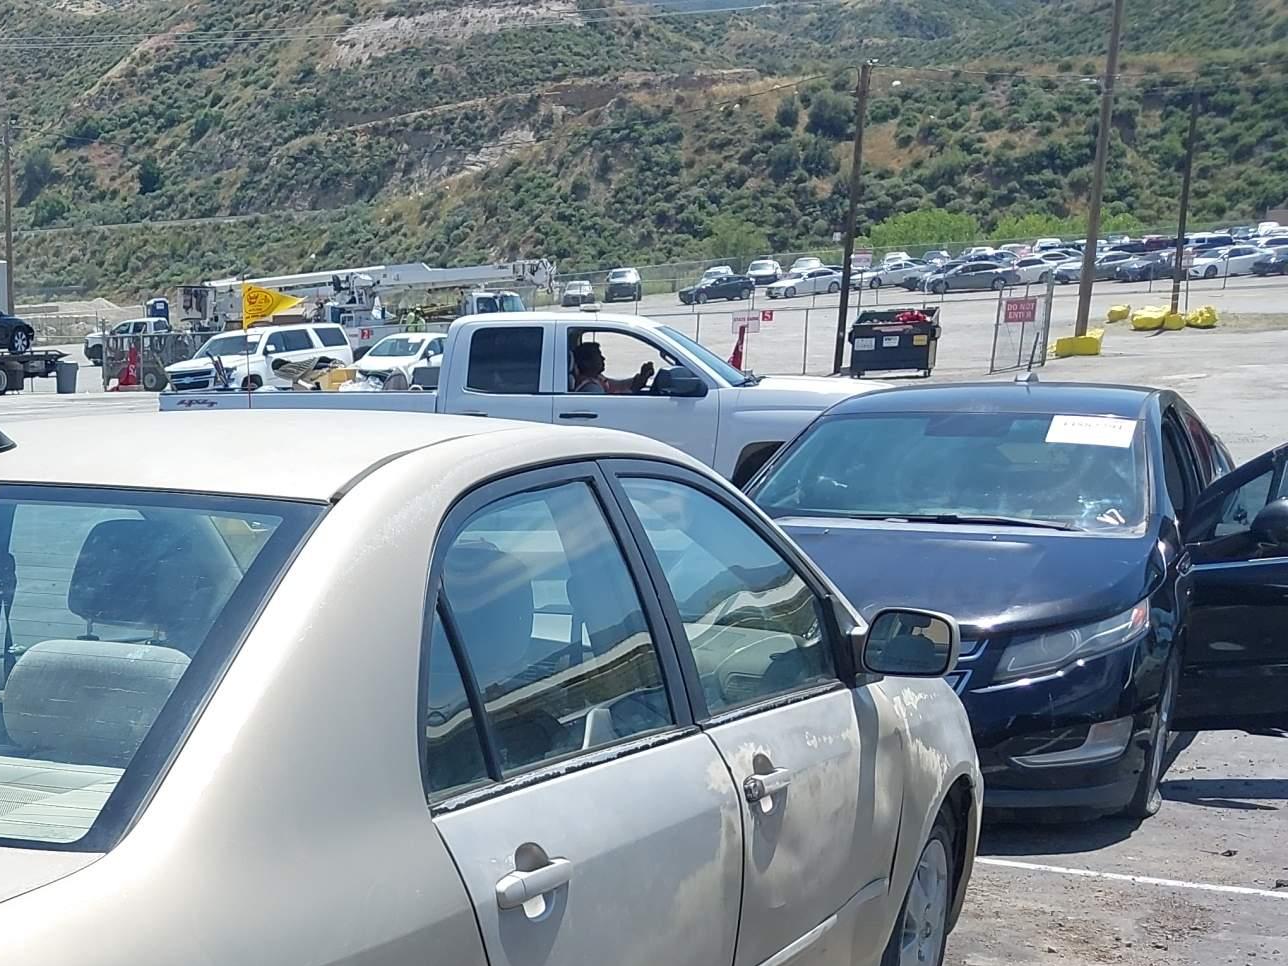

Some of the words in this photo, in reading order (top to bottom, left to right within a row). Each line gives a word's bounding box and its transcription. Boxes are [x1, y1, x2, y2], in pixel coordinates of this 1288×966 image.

[1007, 303, 1018, 311] DO
[1019, 302, 1035, 310] NOT
[1008, 311, 1032, 319] ENTER
